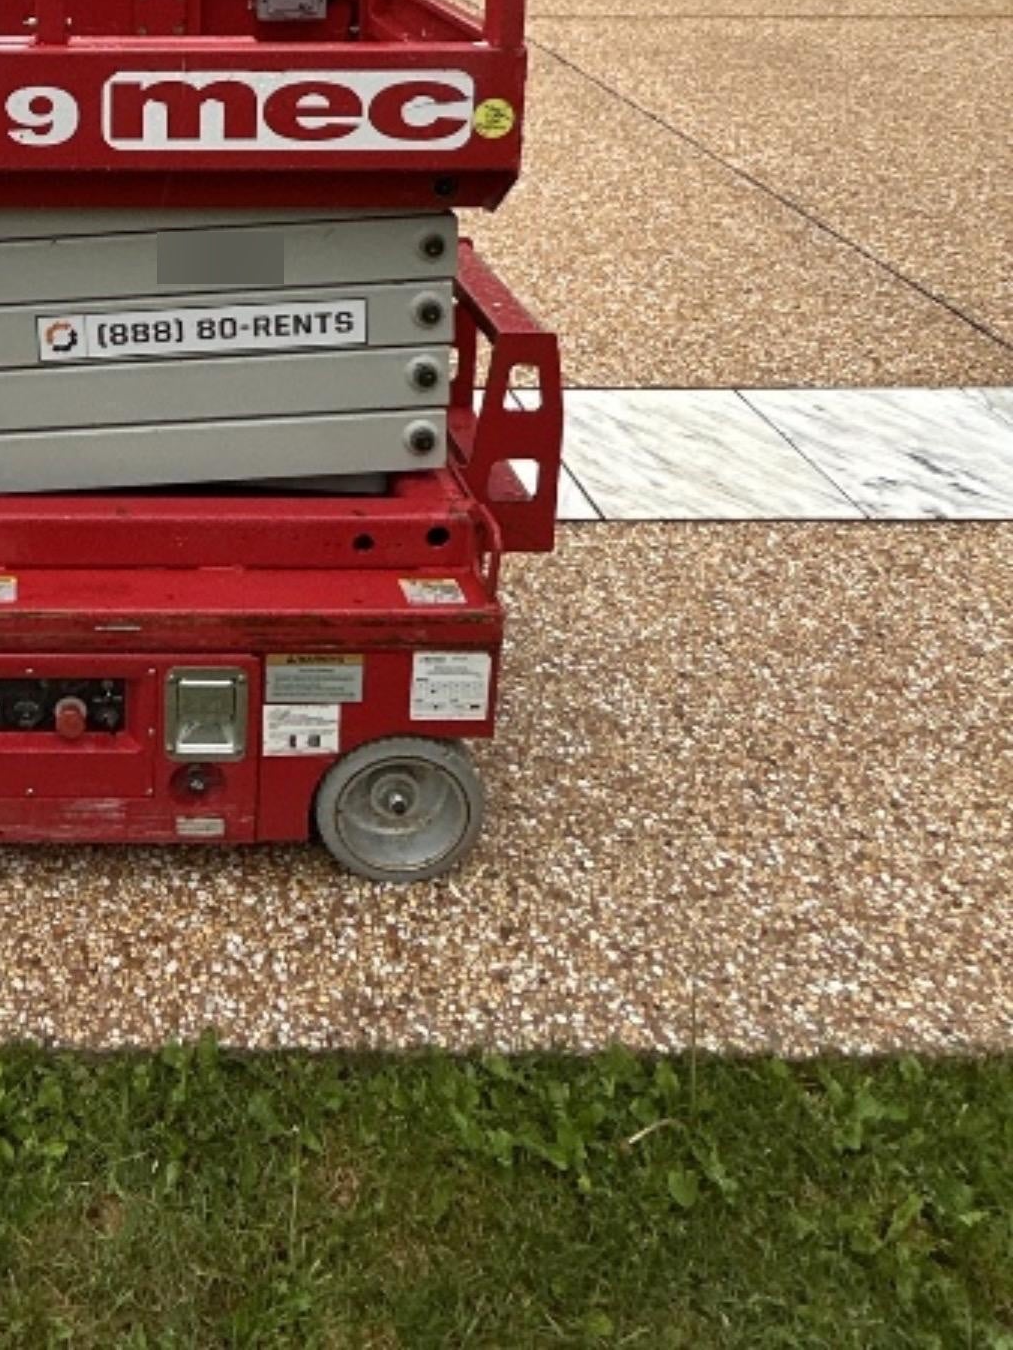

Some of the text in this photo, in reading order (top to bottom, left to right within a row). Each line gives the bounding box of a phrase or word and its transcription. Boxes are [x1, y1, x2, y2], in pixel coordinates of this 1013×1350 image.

[108, 77, 471, 143] mec
[96, 310, 355, 349] (888) 80-RENTS
